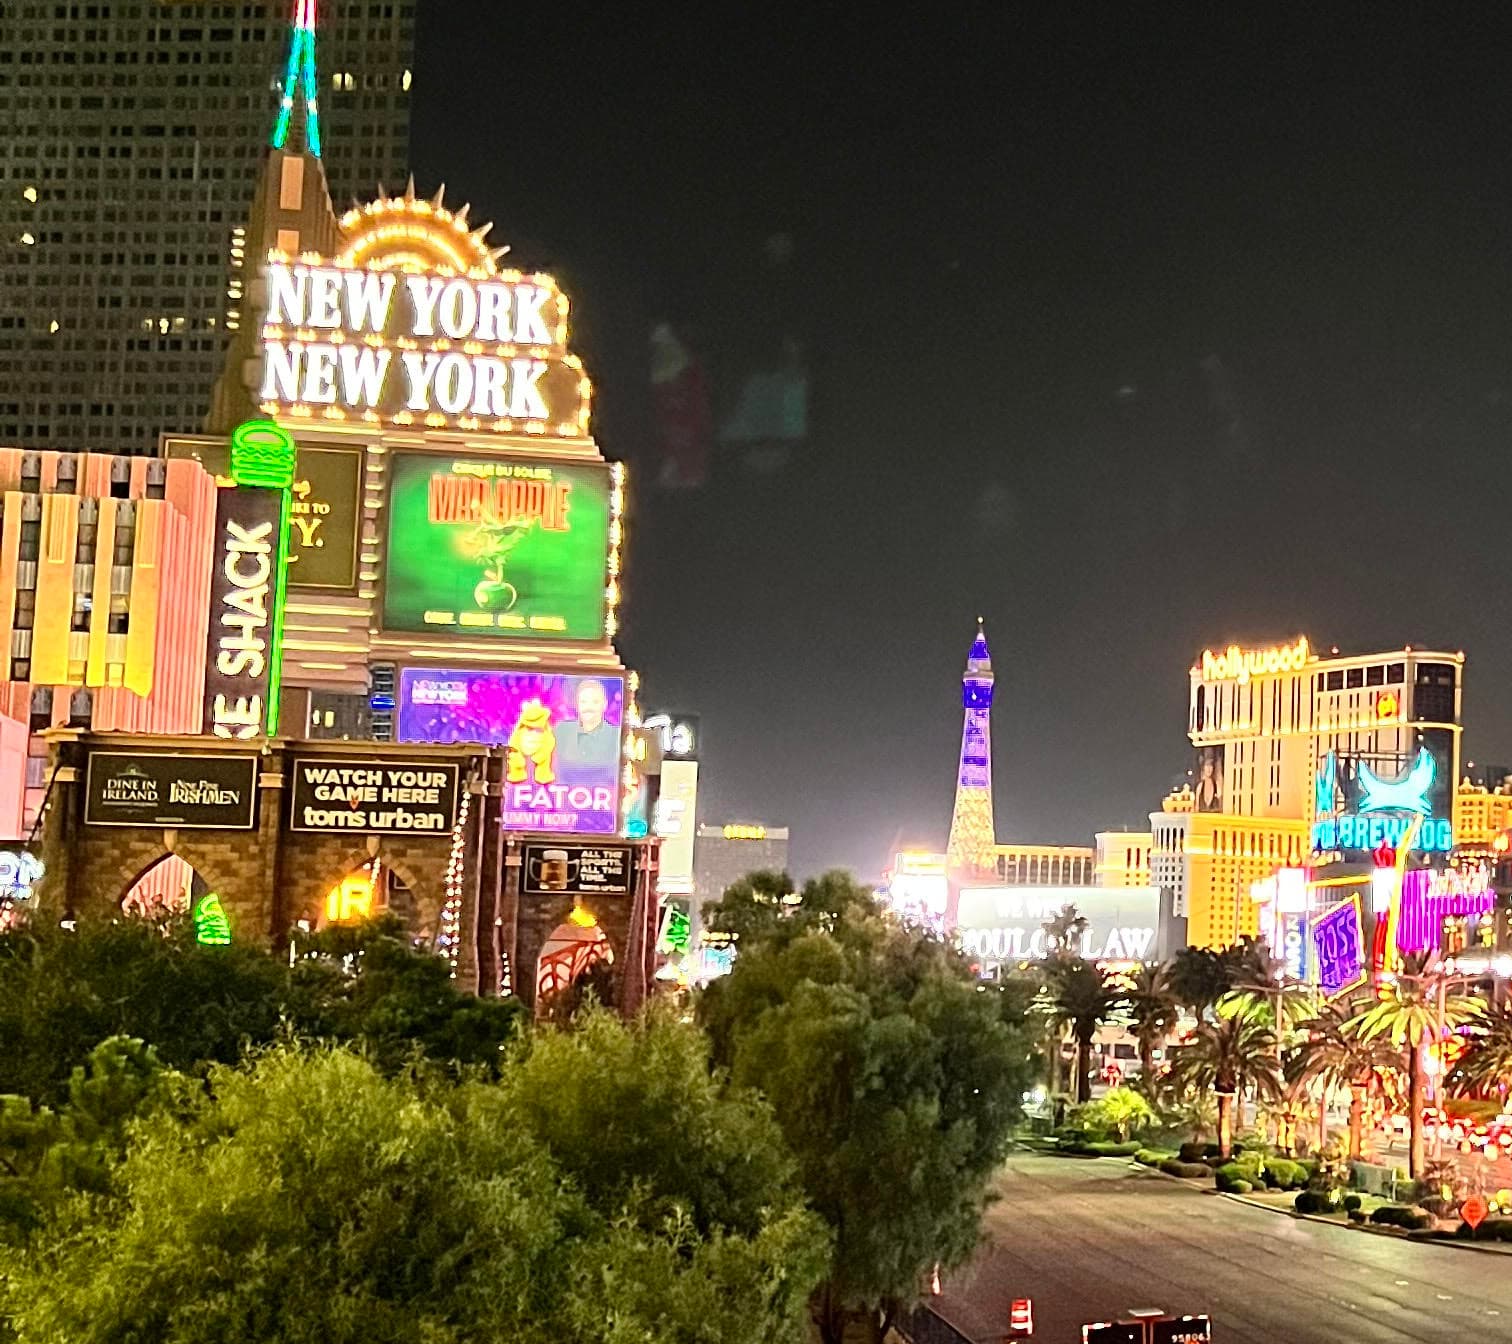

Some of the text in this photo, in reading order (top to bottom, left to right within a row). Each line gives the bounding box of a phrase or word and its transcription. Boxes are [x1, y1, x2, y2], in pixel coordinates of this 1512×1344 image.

[267, 263, 553, 346] NEW YORK
[261, 341, 549, 420] NEW YORK
[216, 518, 273, 678] SHACK
[1202, 637, 1307, 685] hollywood
[107, 779, 157, 790] DINE IN
[304, 768, 447, 788] WATCH YOUR
[102, 789, 159, 801] IRELAND
[314, 785, 440, 804] GAME HERE
[513, 784, 611, 810] FATOR
[369, 807, 444, 829] urban
[1080, 928, 1155, 959] LAW
